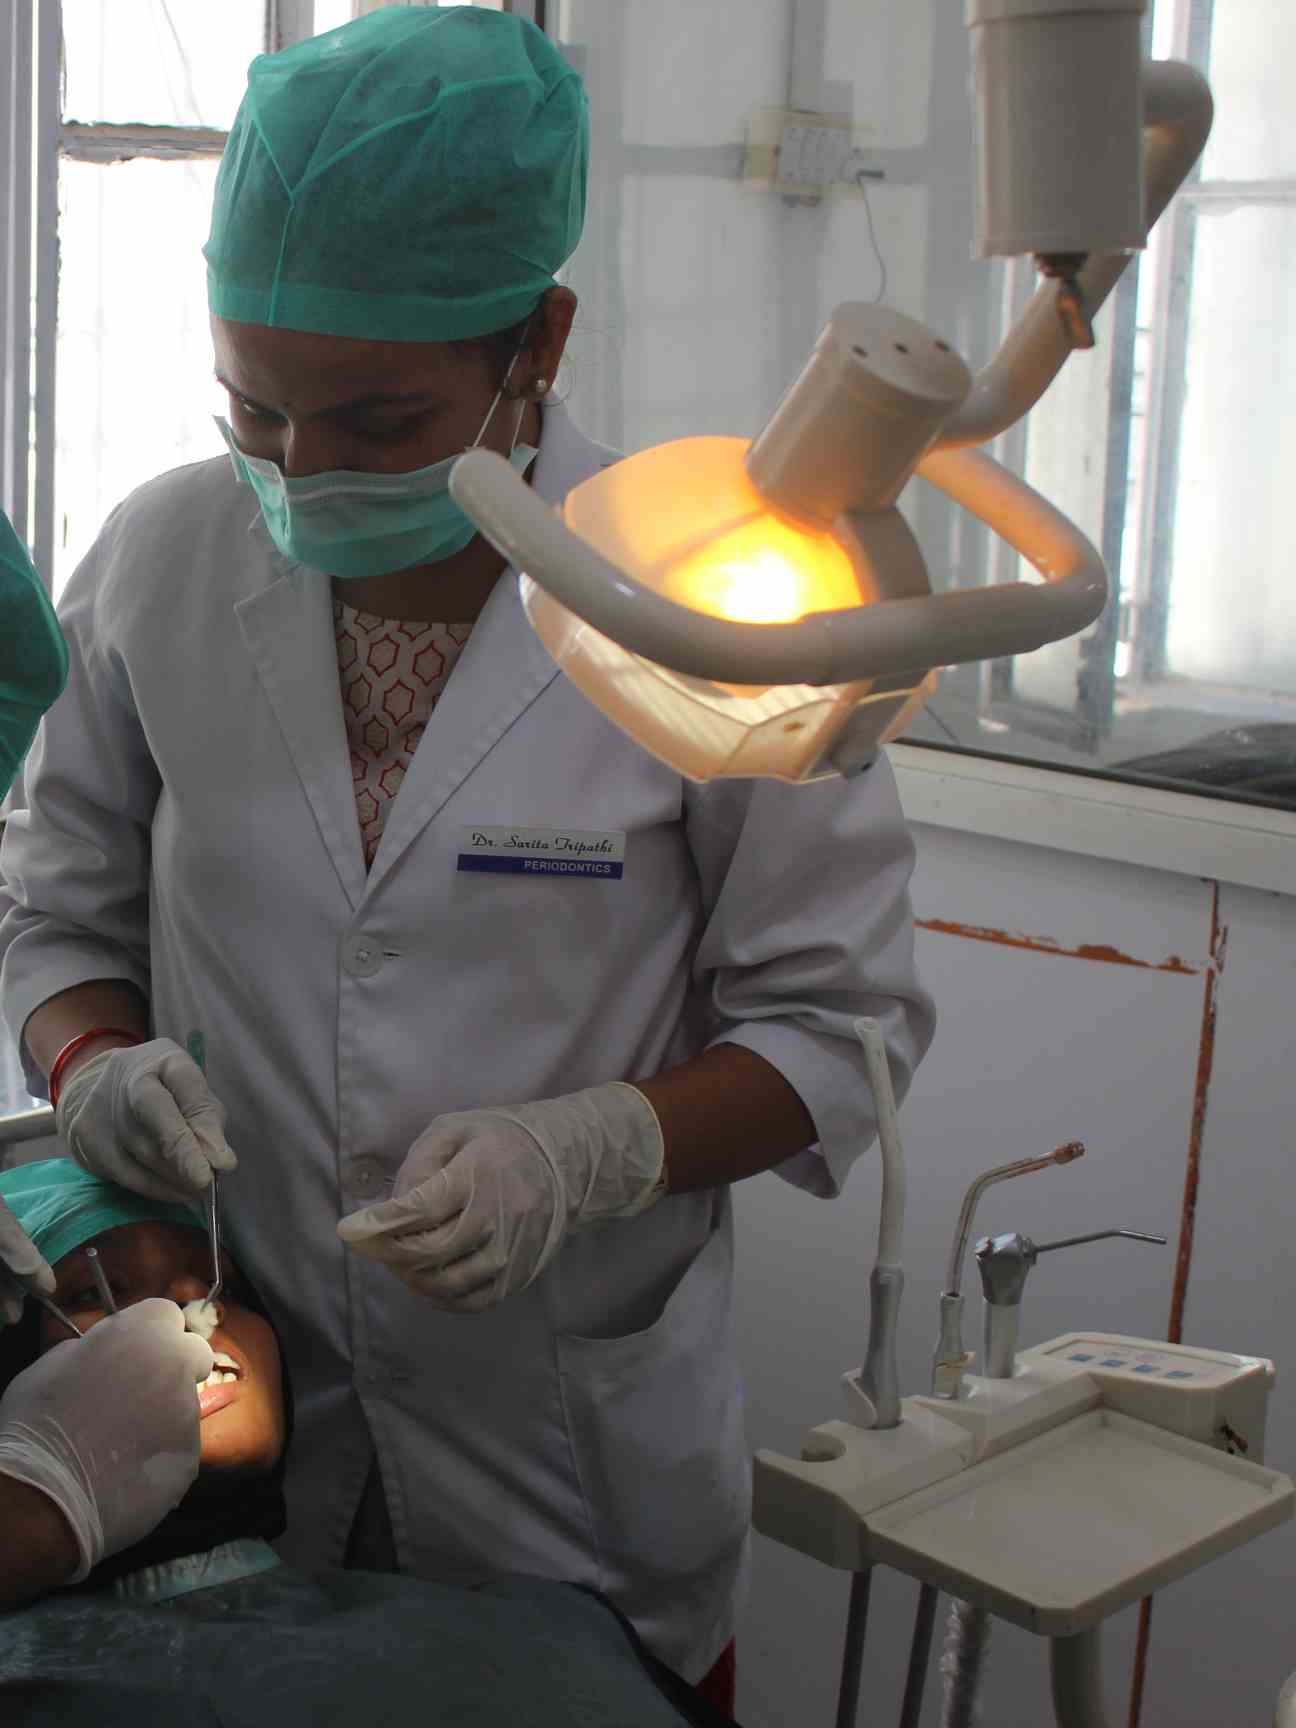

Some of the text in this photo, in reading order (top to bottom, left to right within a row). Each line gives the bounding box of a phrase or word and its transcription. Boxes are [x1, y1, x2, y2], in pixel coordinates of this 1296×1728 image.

[472, 832, 614, 856] Dr. Sarita Tripathi
[524, 860, 611, 873] PERIODONTICS
